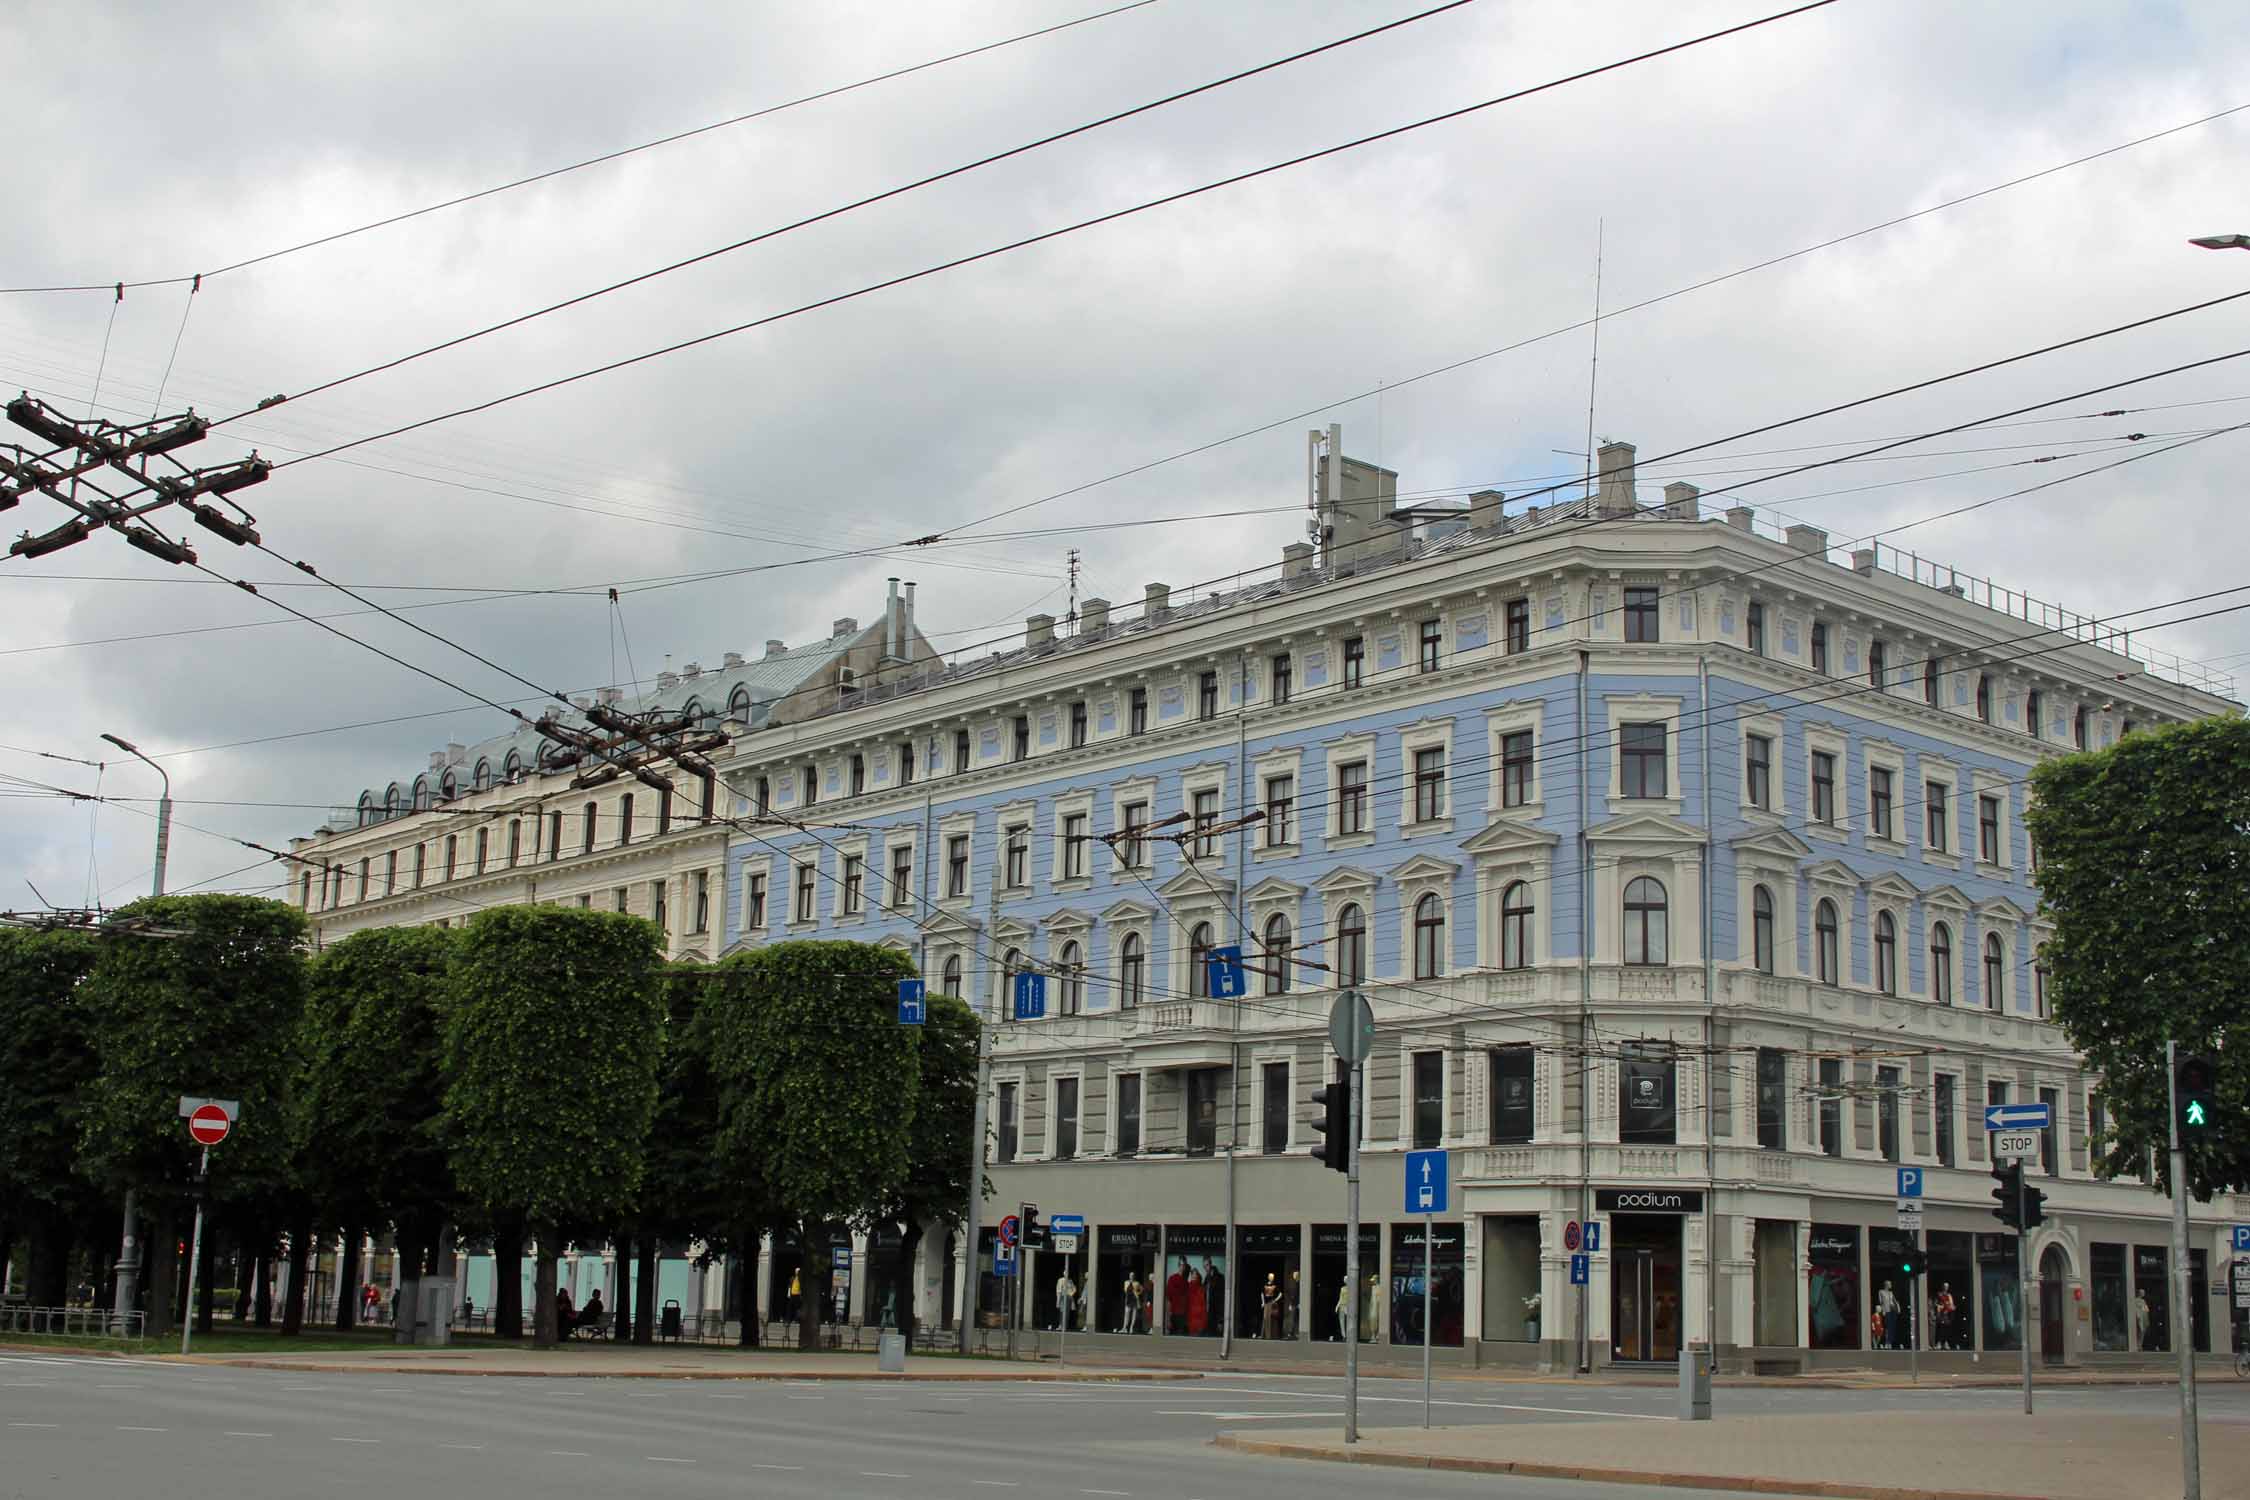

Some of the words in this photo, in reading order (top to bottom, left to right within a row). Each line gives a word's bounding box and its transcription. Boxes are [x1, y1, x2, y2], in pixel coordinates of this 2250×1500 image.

[2001, 1137, 2032, 1151] STOP
[1902, 1170, 1916, 1193] P
[1617, 1192, 1681, 1209] podium
[1059, 1239, 1074, 1249] STOP
[2238, 1228, 2250, 1248] P
